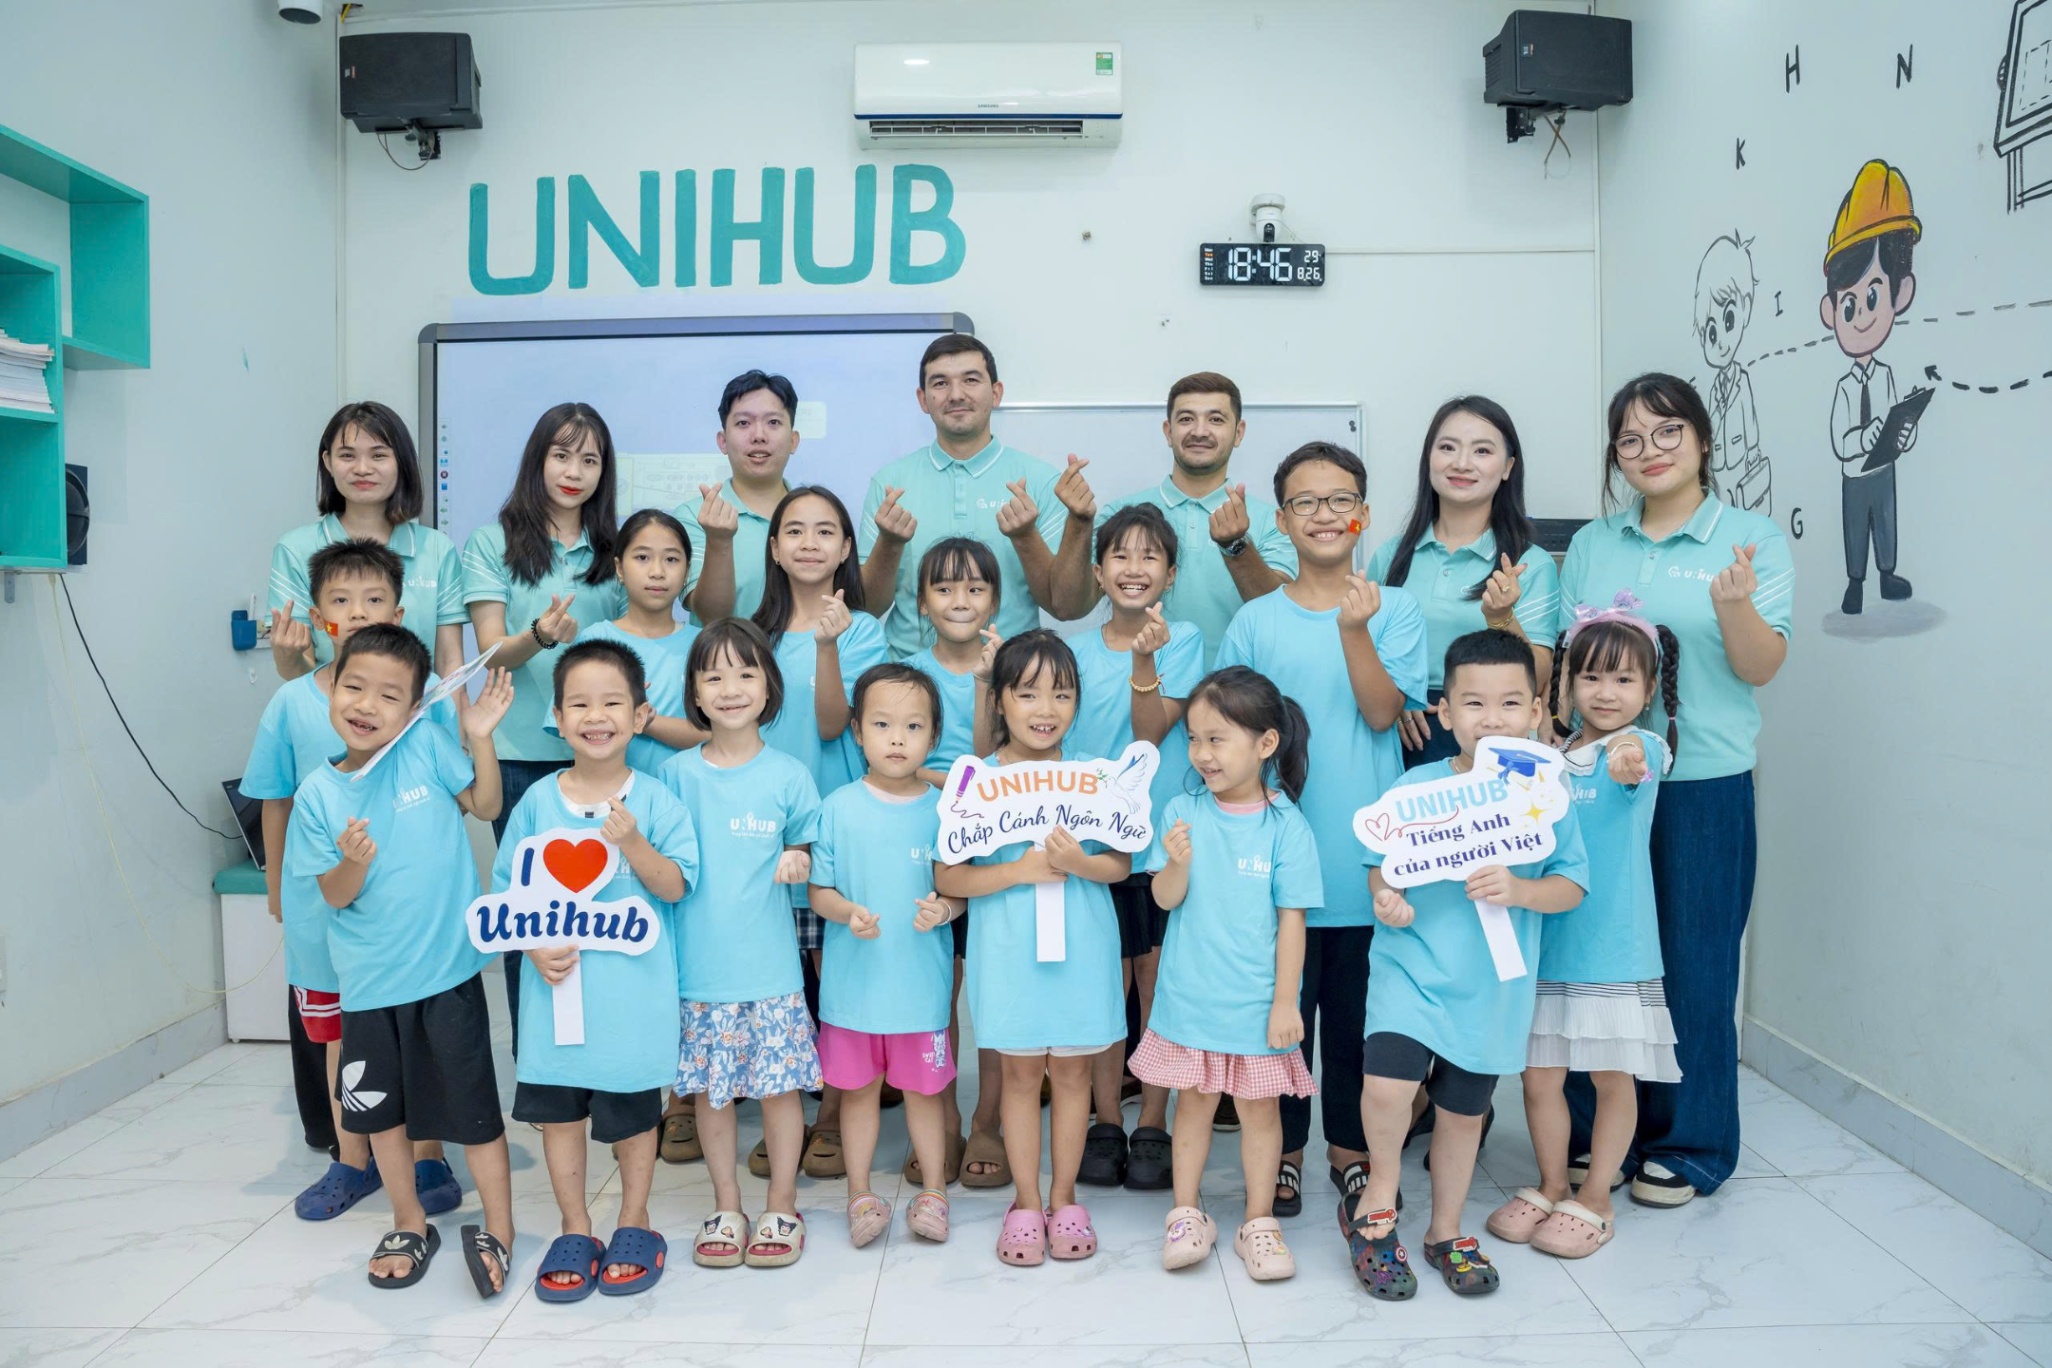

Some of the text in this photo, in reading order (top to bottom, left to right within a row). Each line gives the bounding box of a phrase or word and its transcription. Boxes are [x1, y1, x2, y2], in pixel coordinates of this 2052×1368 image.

[1786, 44, 1800, 93] H
[1896, 44, 1913, 89] N
[1736, 137, 1746, 170] K
[468, 163, 967, 296] UNIHUB
[1228, 247, 1293, 281] 18:46
[1790, 507, 1804, 540] G
[977, 770, 1098, 802] UNIHUB
[1395, 778, 1508, 822] UNIHUB
[947, 804, 1147, 854] Chắp Cánh Ngôn Ngữ
[1406, 813, 1511, 847] Tiếng Anh
[1393, 832, 1543, 876] của người Việt
[477, 900, 649, 942] Unihub
